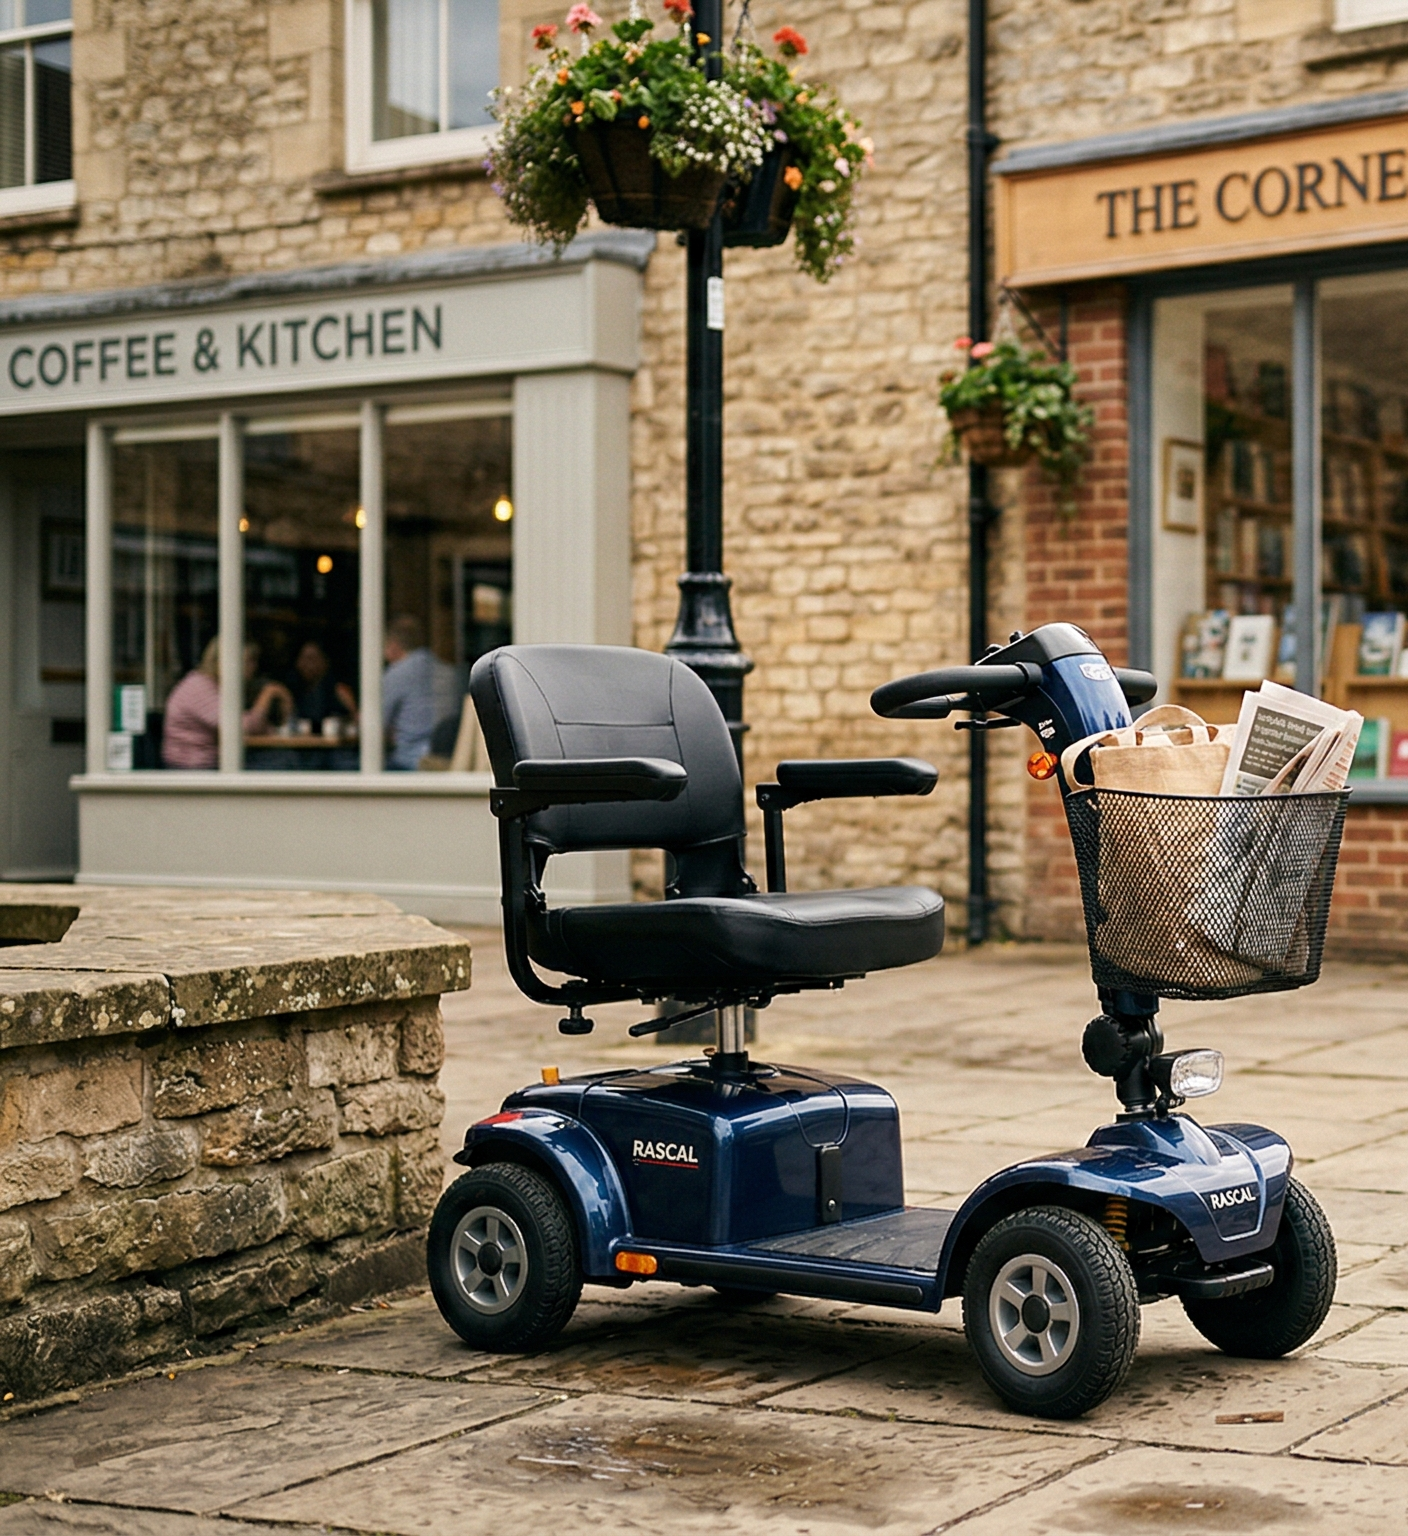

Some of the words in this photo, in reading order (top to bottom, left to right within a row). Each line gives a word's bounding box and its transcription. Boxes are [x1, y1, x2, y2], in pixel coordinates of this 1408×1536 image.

[1097, 178, 1199, 238] THE
[8, 333, 176, 389] COFFEE
[193, 327, 219, 373] &
[237, 304, 442, 368] KITCHEN
[633, 1140, 698, 1163] RASCAL
[1210, 1186, 1256, 1209] RASCAL
